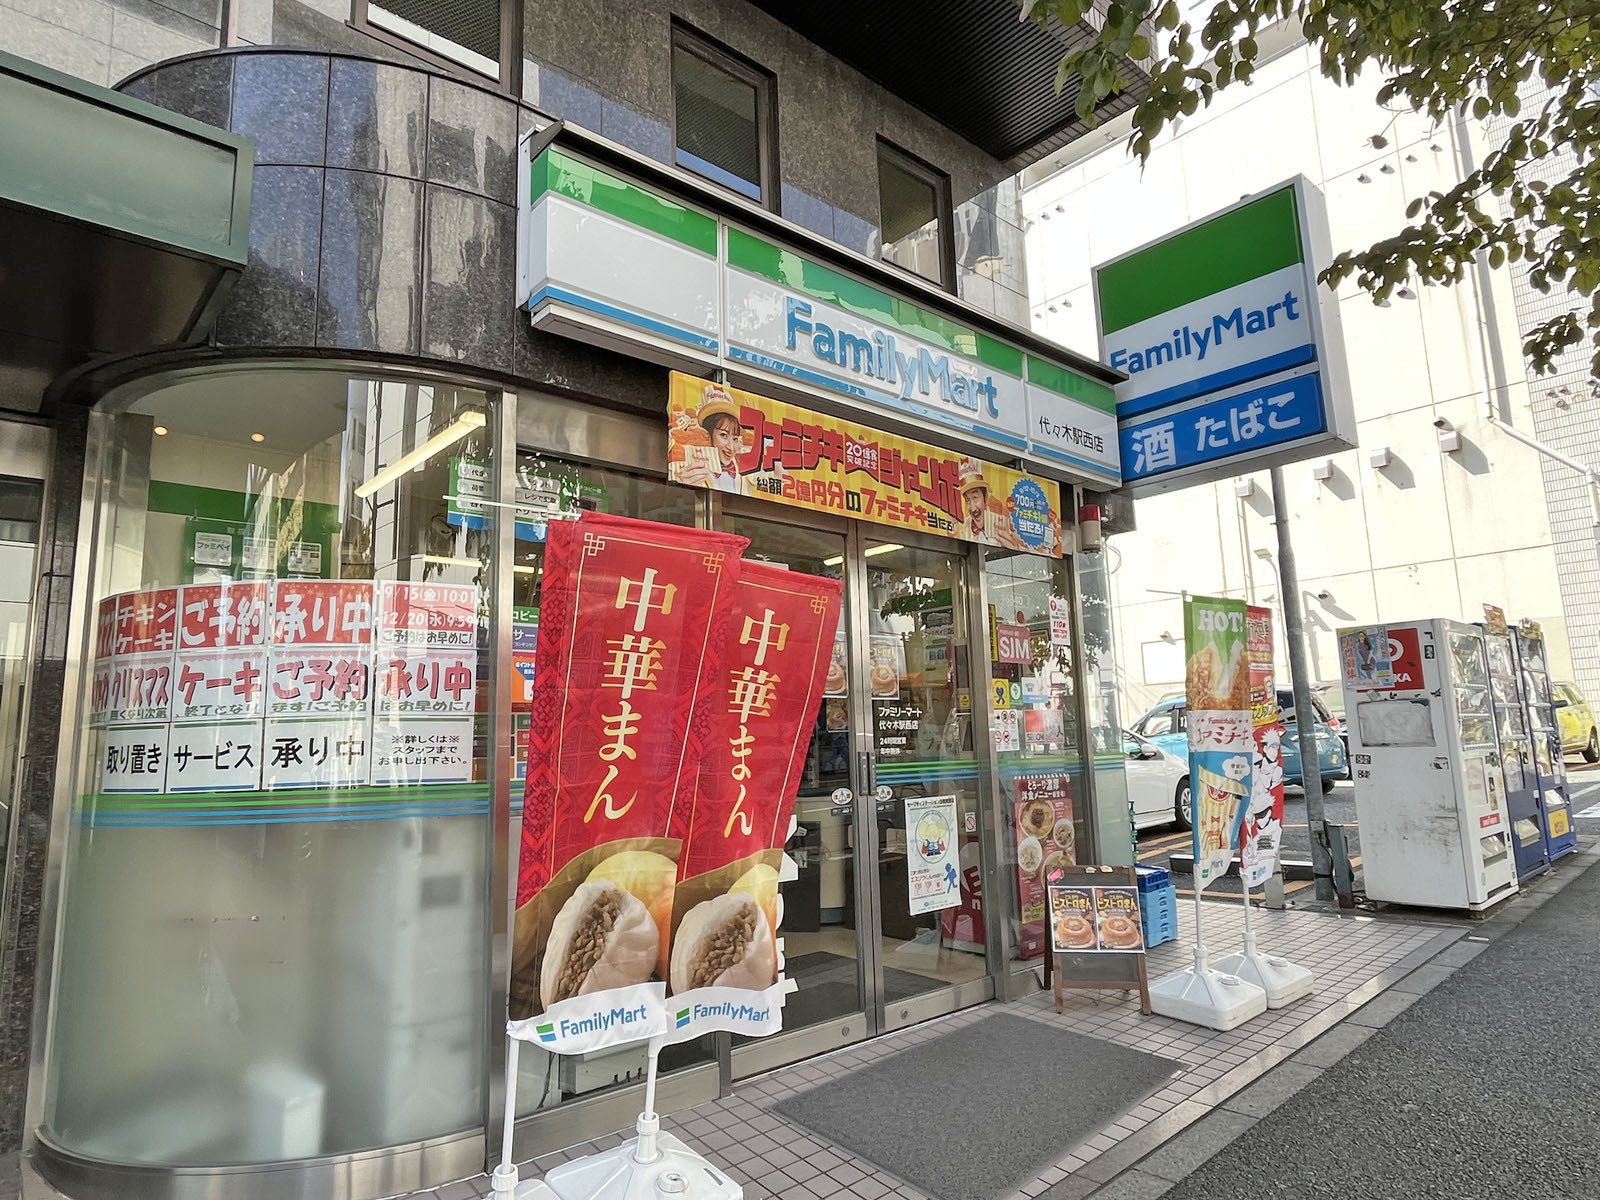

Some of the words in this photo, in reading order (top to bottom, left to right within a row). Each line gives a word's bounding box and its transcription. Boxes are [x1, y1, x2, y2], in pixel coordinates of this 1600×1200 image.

[1110, 290, 1300, 375] FamilyMart
[786, 296, 999, 419] FamilyMart
[1038, 415, 1104, 454] 代々木駅西店
[1131, 421, 1177, 474] 酒
[1195, 391, 1301, 451] たばこ
[739, 405, 844, 476] ファミチキ
[879, 447, 965, 524] ジャンボ
[196, 541, 231, 552] ファミペイ
[118, 602, 175, 627] チキン
[182, 596, 266, 646] ご予約
[274, 593, 371, 643] 承り中
[1197, 609, 1244, 633] HOT!
[116, 628, 173, 654] ケーキ
[999, 636, 1030, 660] SIM
[178, 661, 262, 705] ケーキ
[273, 659, 368, 701] ご予約
[380, 659, 472, 701] 承り中
[583, 567, 678, 823] 中華まん
[724, 609, 790, 839] 中華まん
[878, 706, 923, 718] ファミリーマート
[106, 743, 162, 775] 取り置き
[174, 741, 254, 772] サービス
[271, 735, 365, 768] 承り中
[393, 746, 458, 754] スタッフまで
[560, 1003, 647, 1039] FamilyMart
[693, 1002, 770, 1022] FamilyMart
